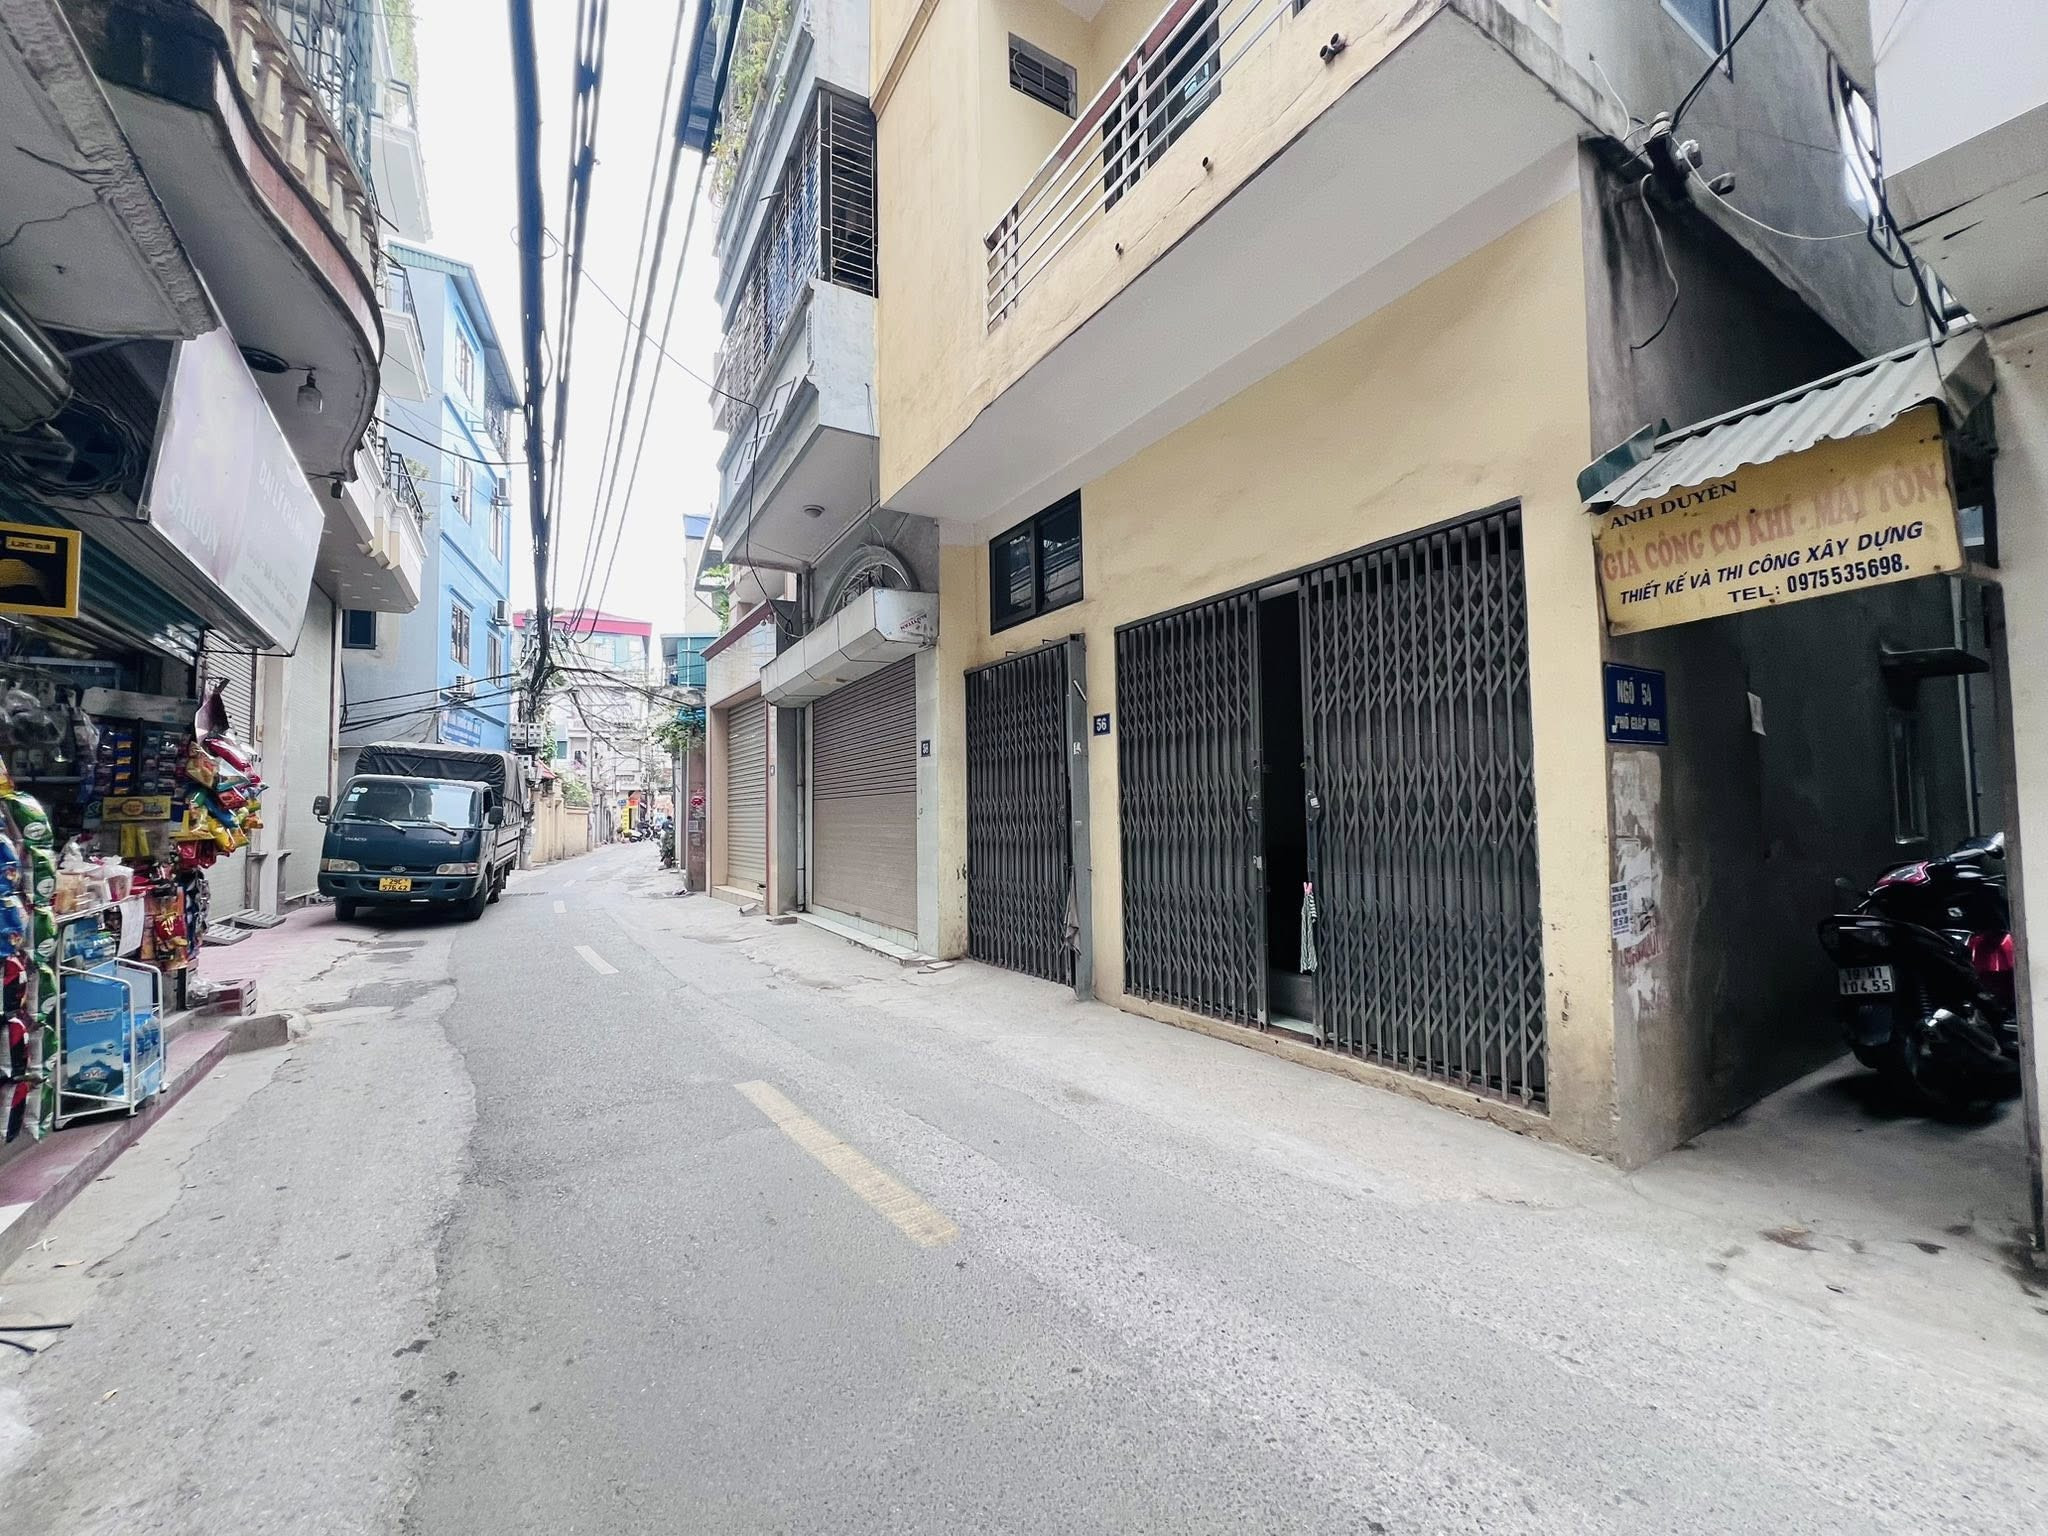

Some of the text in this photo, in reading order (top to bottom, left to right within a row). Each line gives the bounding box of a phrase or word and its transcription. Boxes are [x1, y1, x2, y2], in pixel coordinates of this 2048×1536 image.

[1602, 547, 1643, 582] GIA
[1644, 528, 1706, 571] CÔNG
[1746, 493, 1795, 547] KHÍ
[1609, 505, 1654, 530] ANH
[1620, 520, 1924, 605] THIẾT KẾ VÀ THI CÔNG XÂY DỰNG
[1096, 717, 1107, 732] 56
